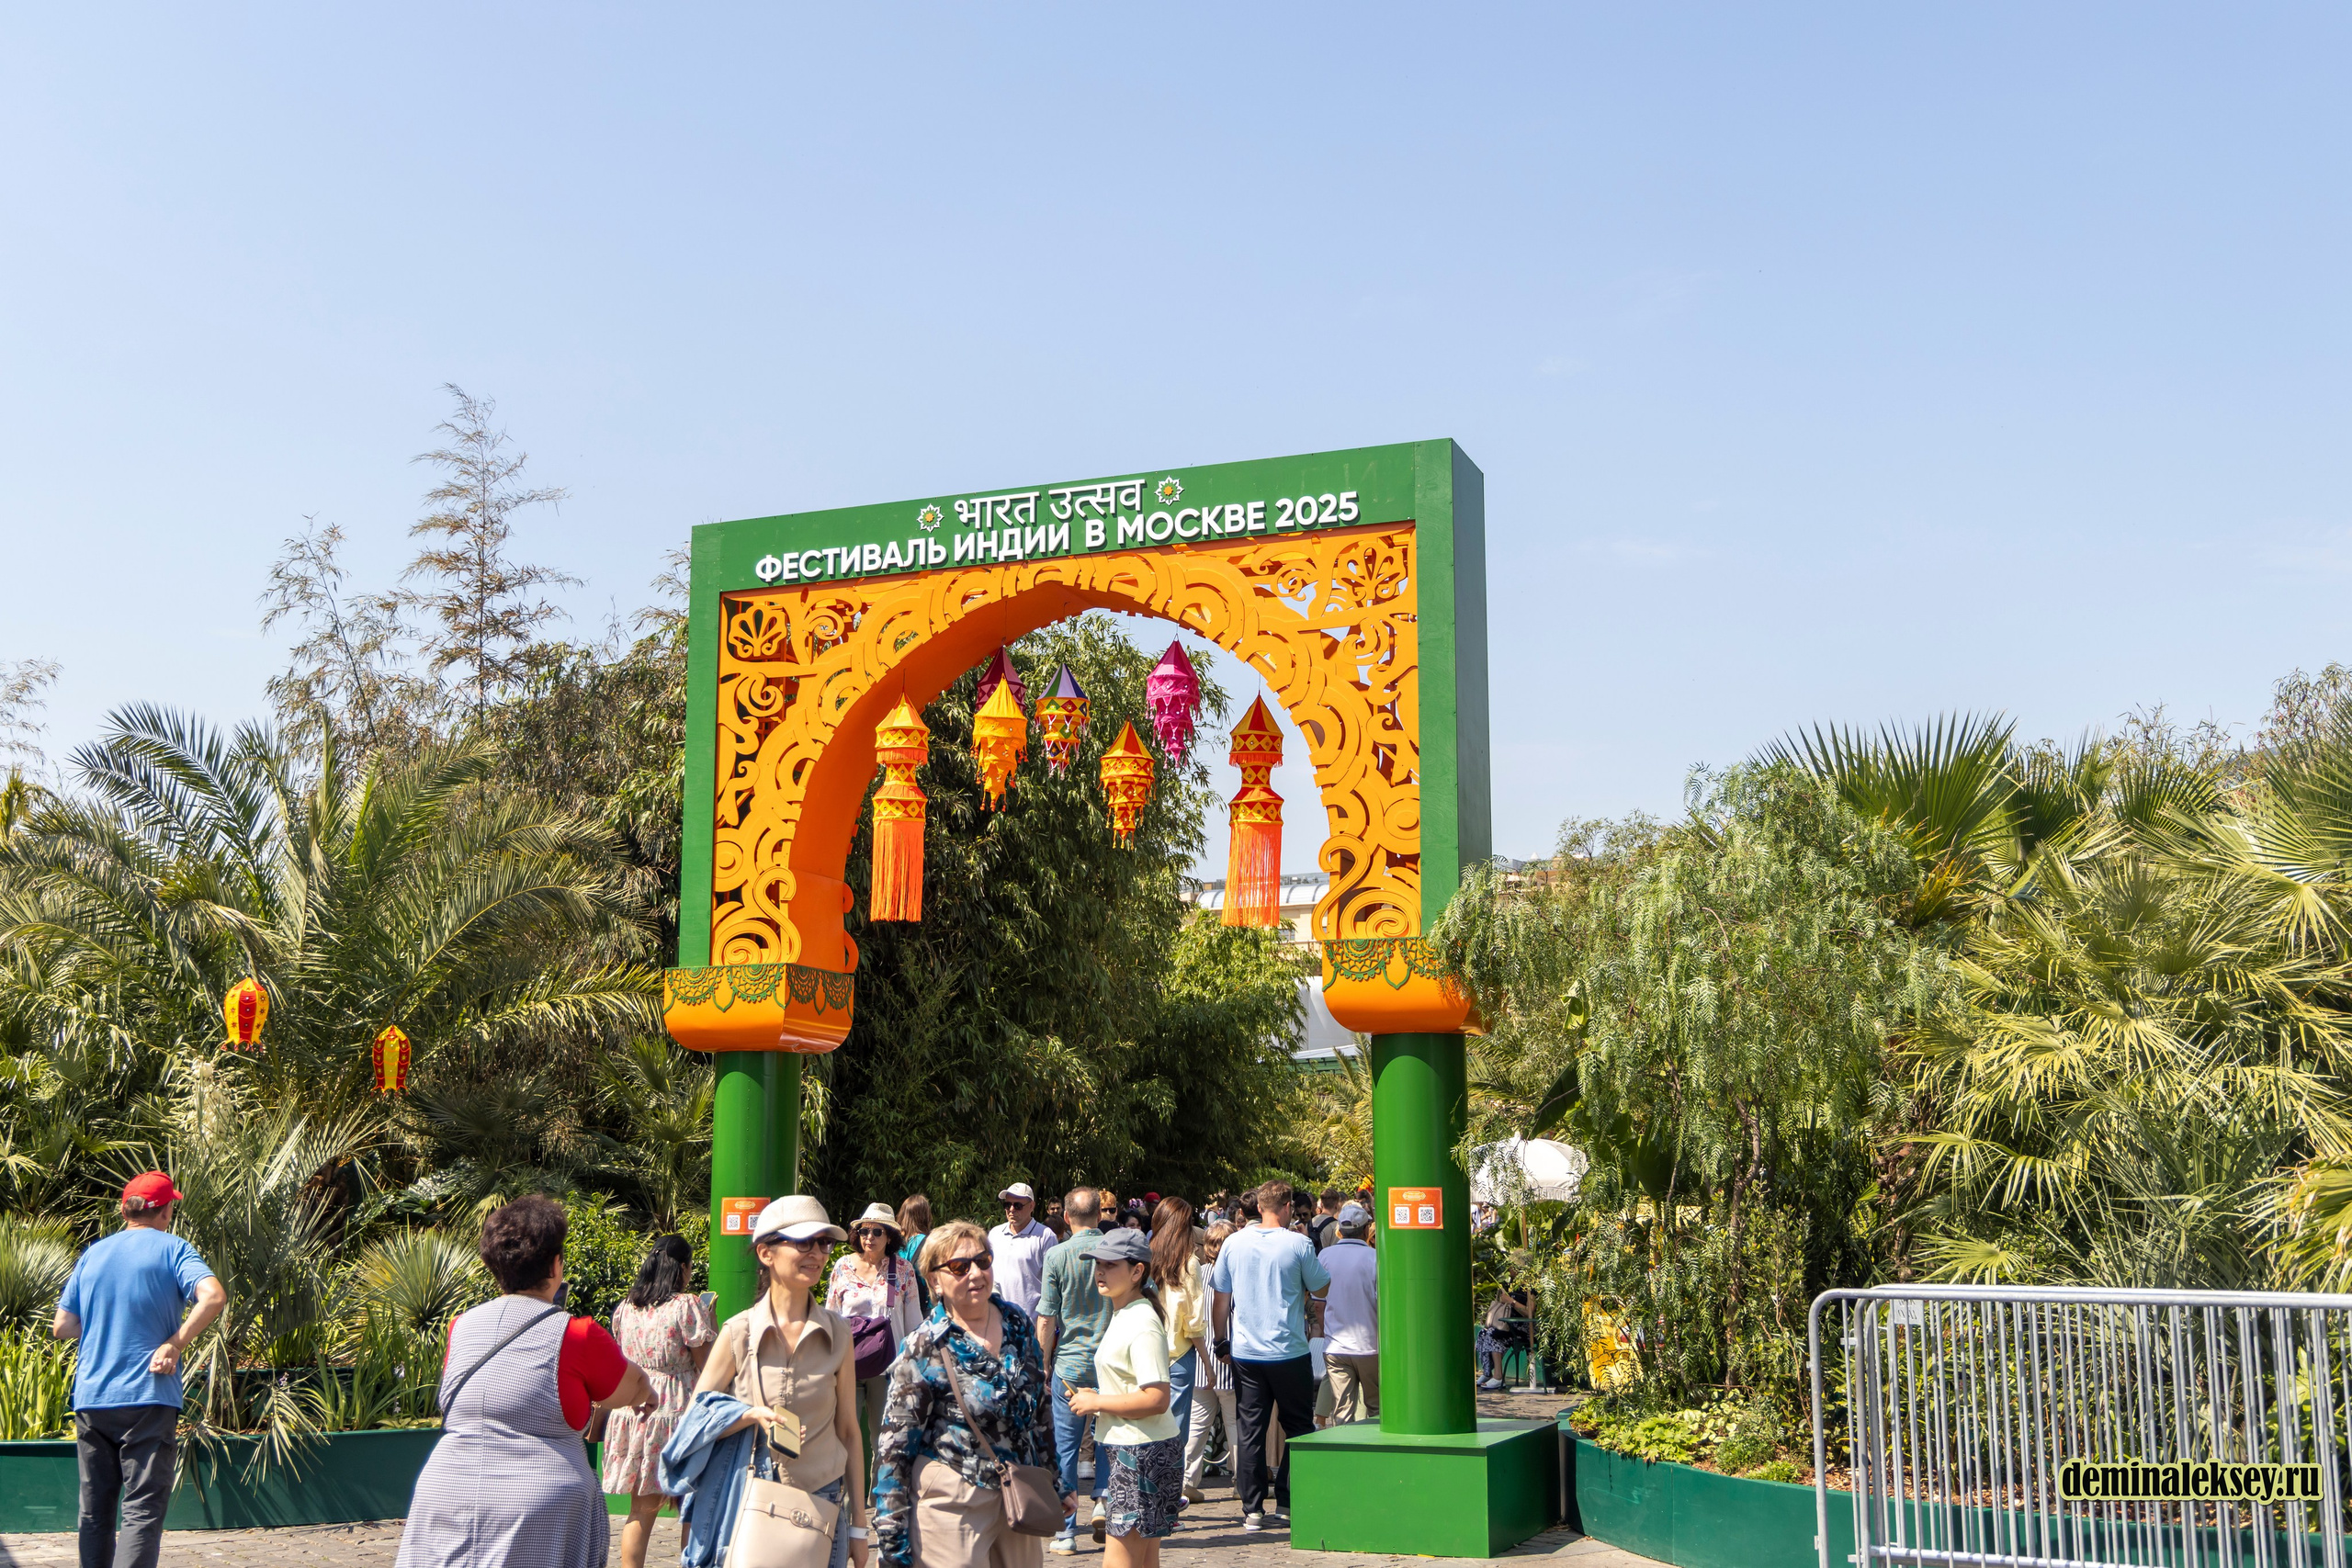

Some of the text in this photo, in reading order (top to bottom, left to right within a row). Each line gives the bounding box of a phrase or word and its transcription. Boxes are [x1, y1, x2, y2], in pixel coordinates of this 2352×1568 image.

[754, 491, 1359, 582] ФЕСТИВАЛЬ ИНДИИ В МОСКВЕ 2025
[954, 479, 1147, 529] भारत उत्सव
